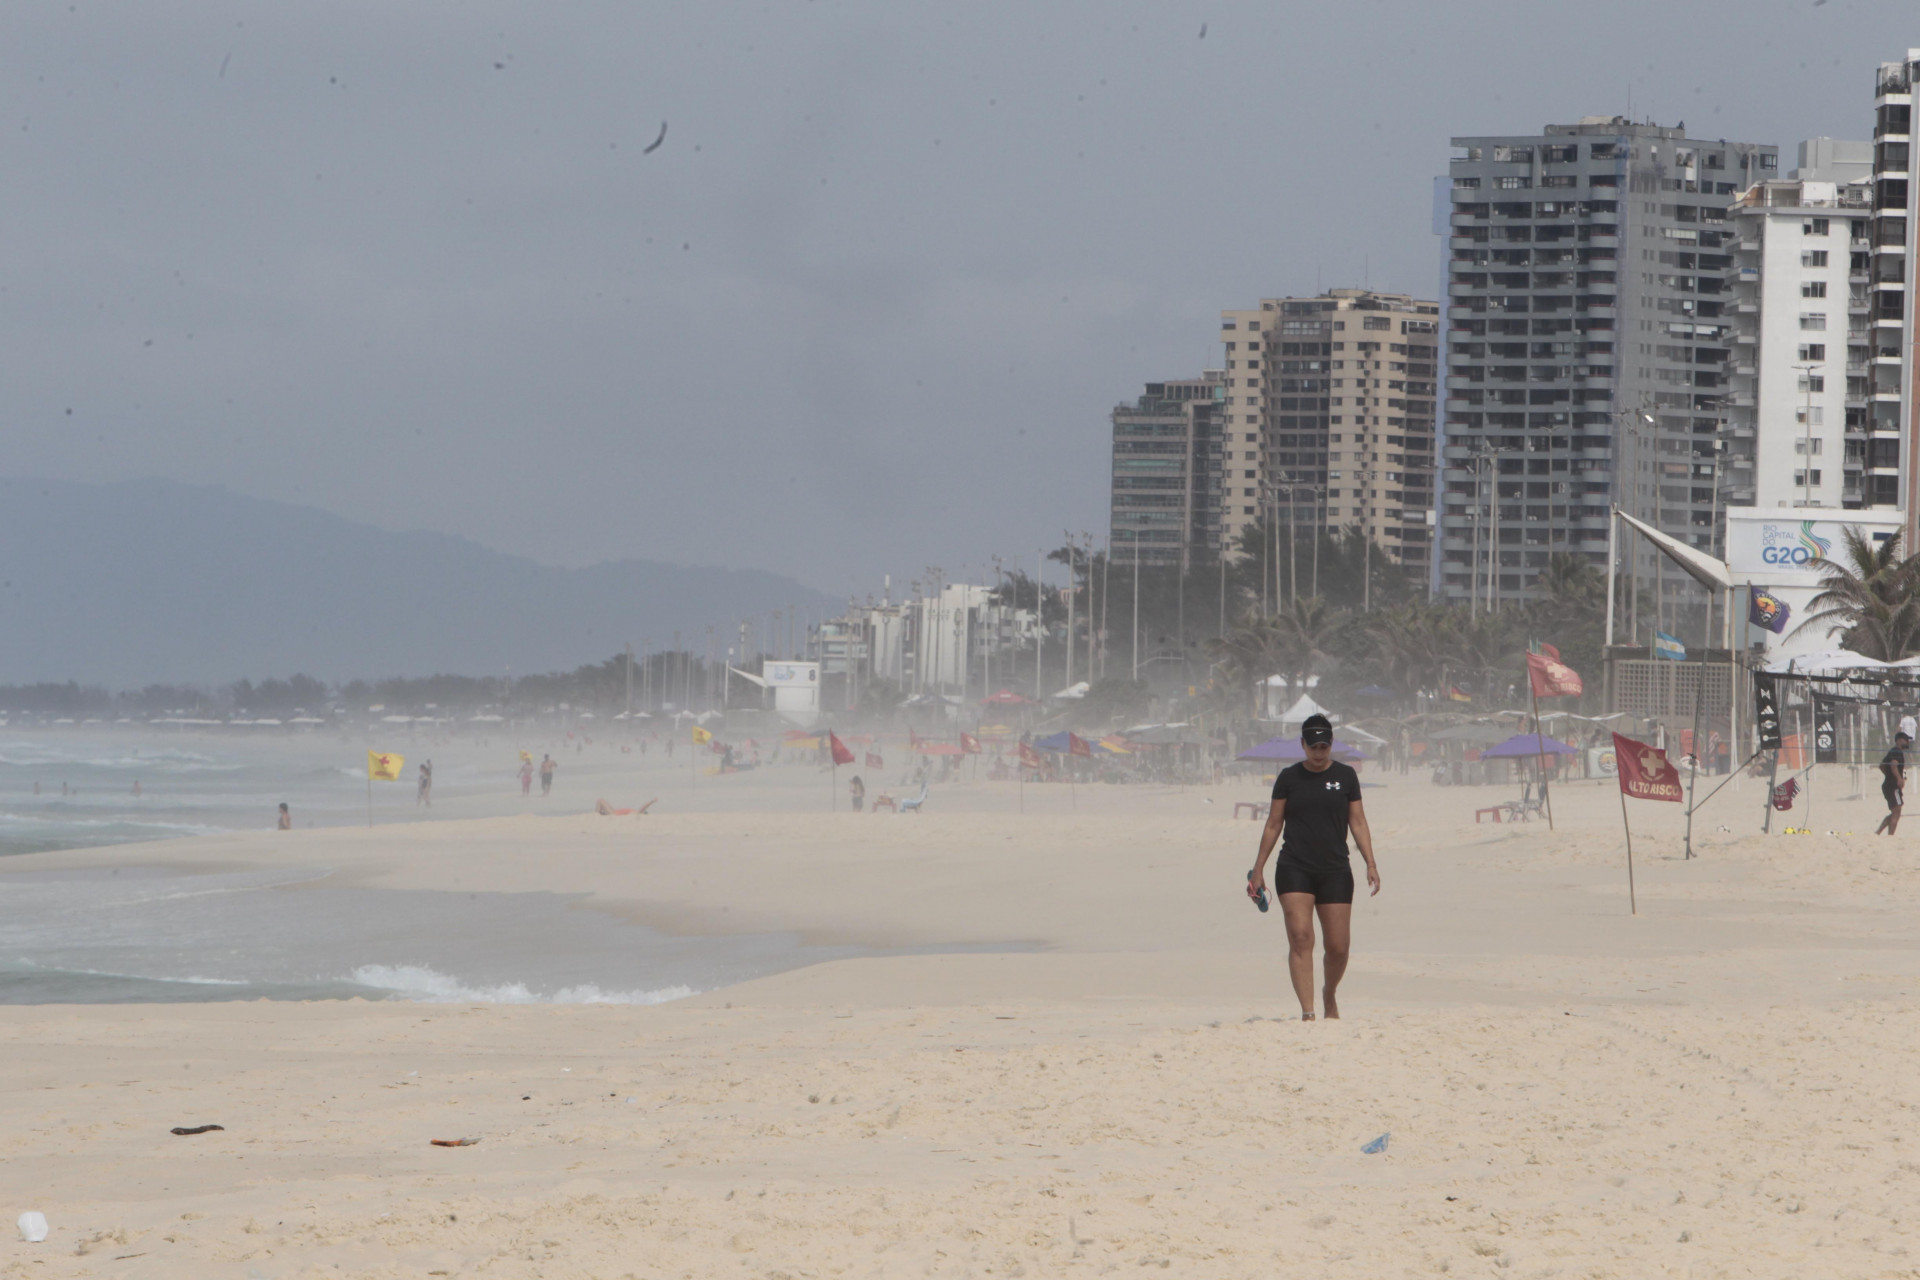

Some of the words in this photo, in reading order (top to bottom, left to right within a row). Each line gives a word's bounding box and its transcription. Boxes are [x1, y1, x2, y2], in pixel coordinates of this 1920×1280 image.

[1762, 546, 1809, 564] G20
[809, 669, 816, 681] 8
[1650, 783, 1679, 796] RISCO
